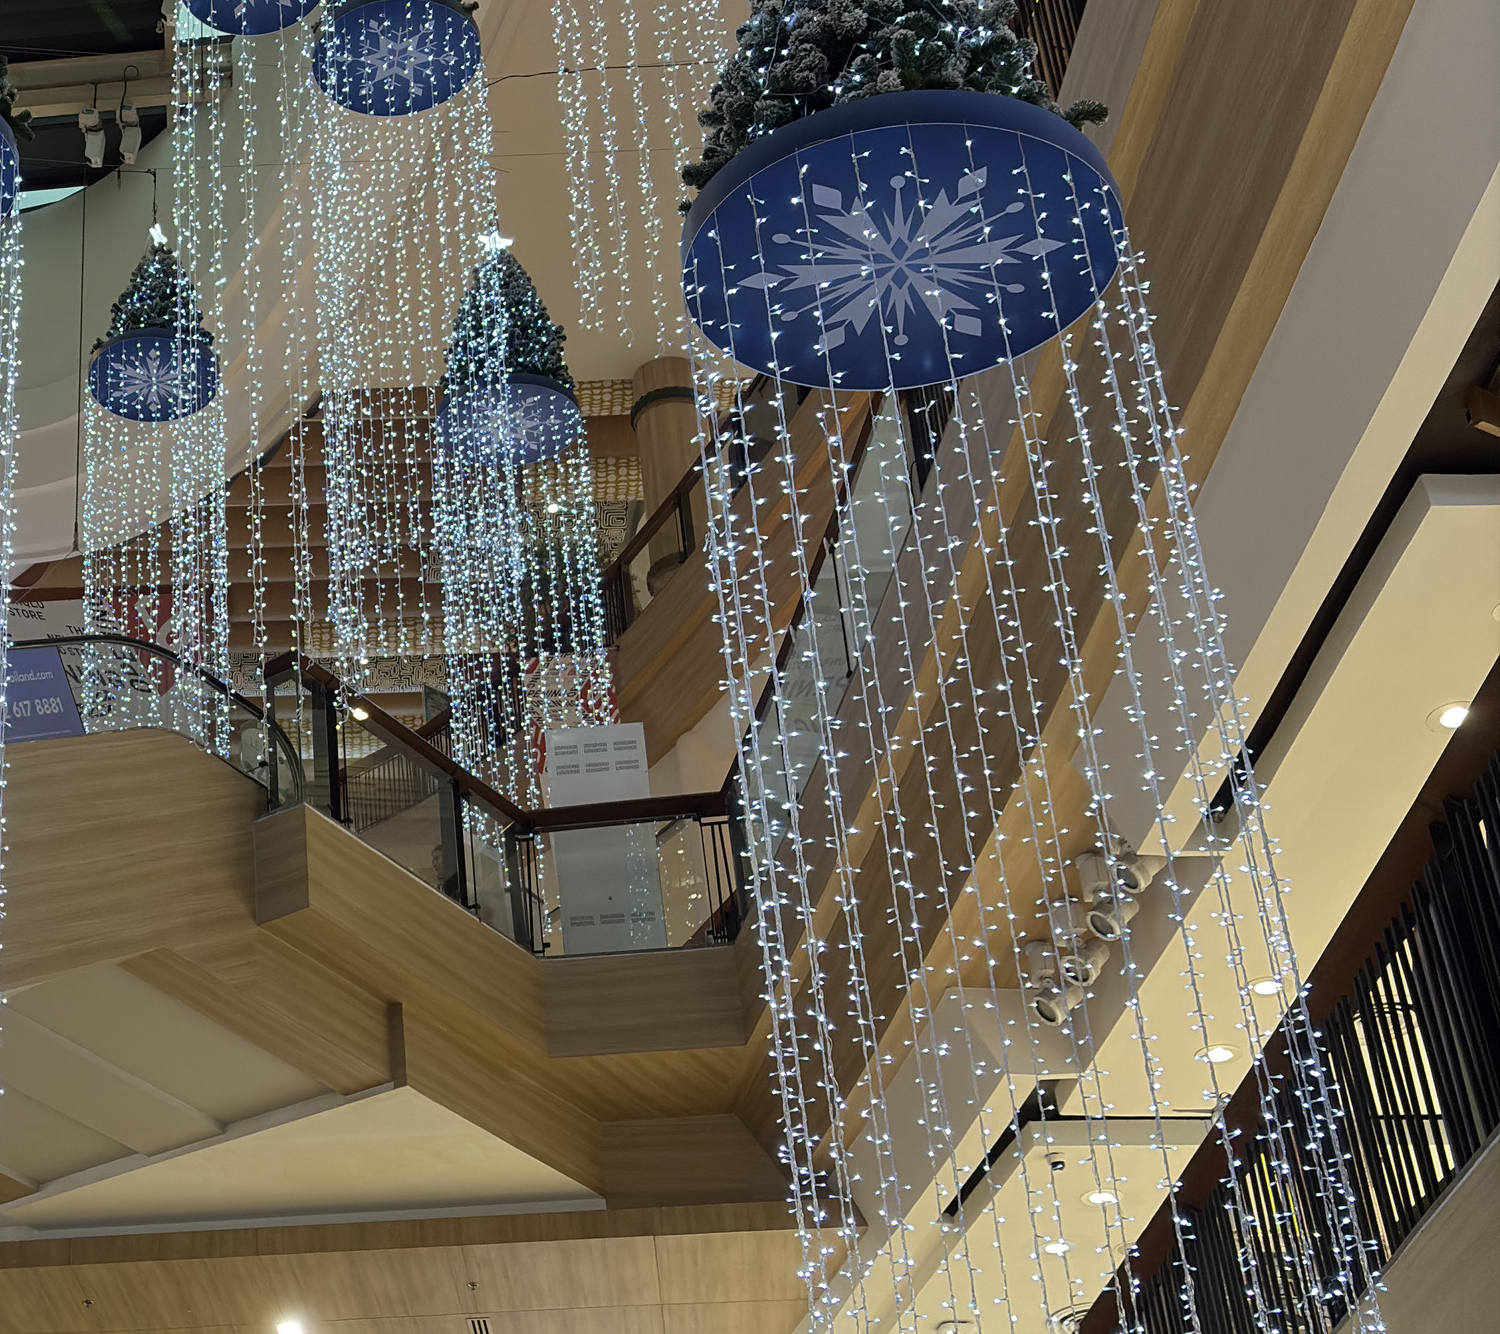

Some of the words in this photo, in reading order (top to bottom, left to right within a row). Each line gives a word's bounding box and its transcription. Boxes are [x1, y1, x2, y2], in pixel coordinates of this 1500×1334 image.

[8, 607, 47, 621] STORE
[12, 699, 32, 718] 617
[34, 696, 64, 716] 8881
